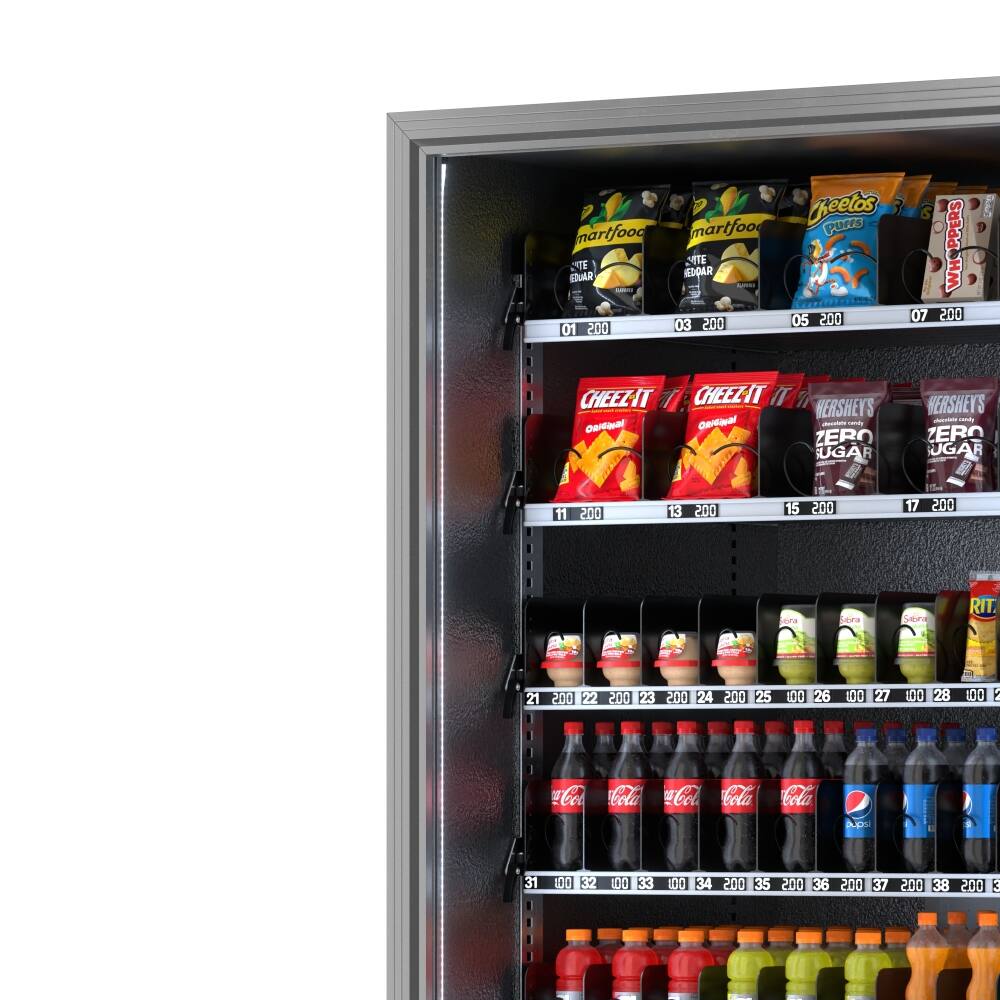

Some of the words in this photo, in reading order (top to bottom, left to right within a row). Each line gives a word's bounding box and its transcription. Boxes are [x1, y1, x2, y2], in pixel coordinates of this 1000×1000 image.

[807, 190, 878, 228] Cheetos
[792, 314, 809, 326] 05
[820, 313, 842, 326] 2.00
[912, 309, 927, 322] 07
[940, 308, 962, 320] 2.00
[562, 323, 576, 336] 01
[587, 322, 609, 335] 2.00
[675, 319, 691, 332] 03
[703, 318, 724, 330] 2.00
[816, 398, 874, 418] HERSHEY'S
[928, 394, 986, 415] HERSHEY'S
[816, 428, 873, 448] ZERO
[928, 425, 984, 444] ZERO
[668, 506, 682, 518] 13
[695, 505, 716, 517] 2.00
[786, 502, 800, 514] 15
[812, 502, 834, 514] 2.00
[906, 500, 920, 512] 17
[932, 499, 954, 512] 2.00
[556, 508, 567, 520] 11
[580, 508, 601, 520] 2.00
[970, 598, 998, 615] RIT
[904, 614, 928, 624] Sabra
[526, 693, 540, 704] 21
[552, 693, 573, 704] 2.00
[582, 692, 598, 704] 22
[609, 692, 630, 704] 2.00
[640, 692, 656, 704] 23
[667, 692, 688, 704] 2.00
[698, 692, 713, 704] 24
[724, 692, 746, 704] 2.00
[756, 691, 772, 703] 25
[787, 690, 804, 702] 1.00
[814, 690, 830, 702] 26
[847, 690, 864, 702] 1.00
[874, 690, 890, 702] 27
[906, 690, 924, 702] 1.00
[934, 689, 950, 702] 28
[966, 689, 984, 702] 1.00
[524, 876, 538, 888] 31
[555, 877, 572, 888] 1.00
[581, 877, 596, 889] 32
[612, 877, 628, 889] 1.00
[638, 877, 654, 889] 33
[668, 878, 686, 890] 1.00
[696, 878, 712, 890] 34
[724, 878, 745, 890] 2.00
[754, 878, 770, 890] 35
[782, 878, 804, 890] 2.00
[812, 878, 830, 890] 36
[841, 878, 862, 891] 2.00
[872, 878, 888, 891] 37
[901, 879, 923, 892] 2.00
[932, 878, 950, 892] 38
[962, 880, 983, 892] 2.00
